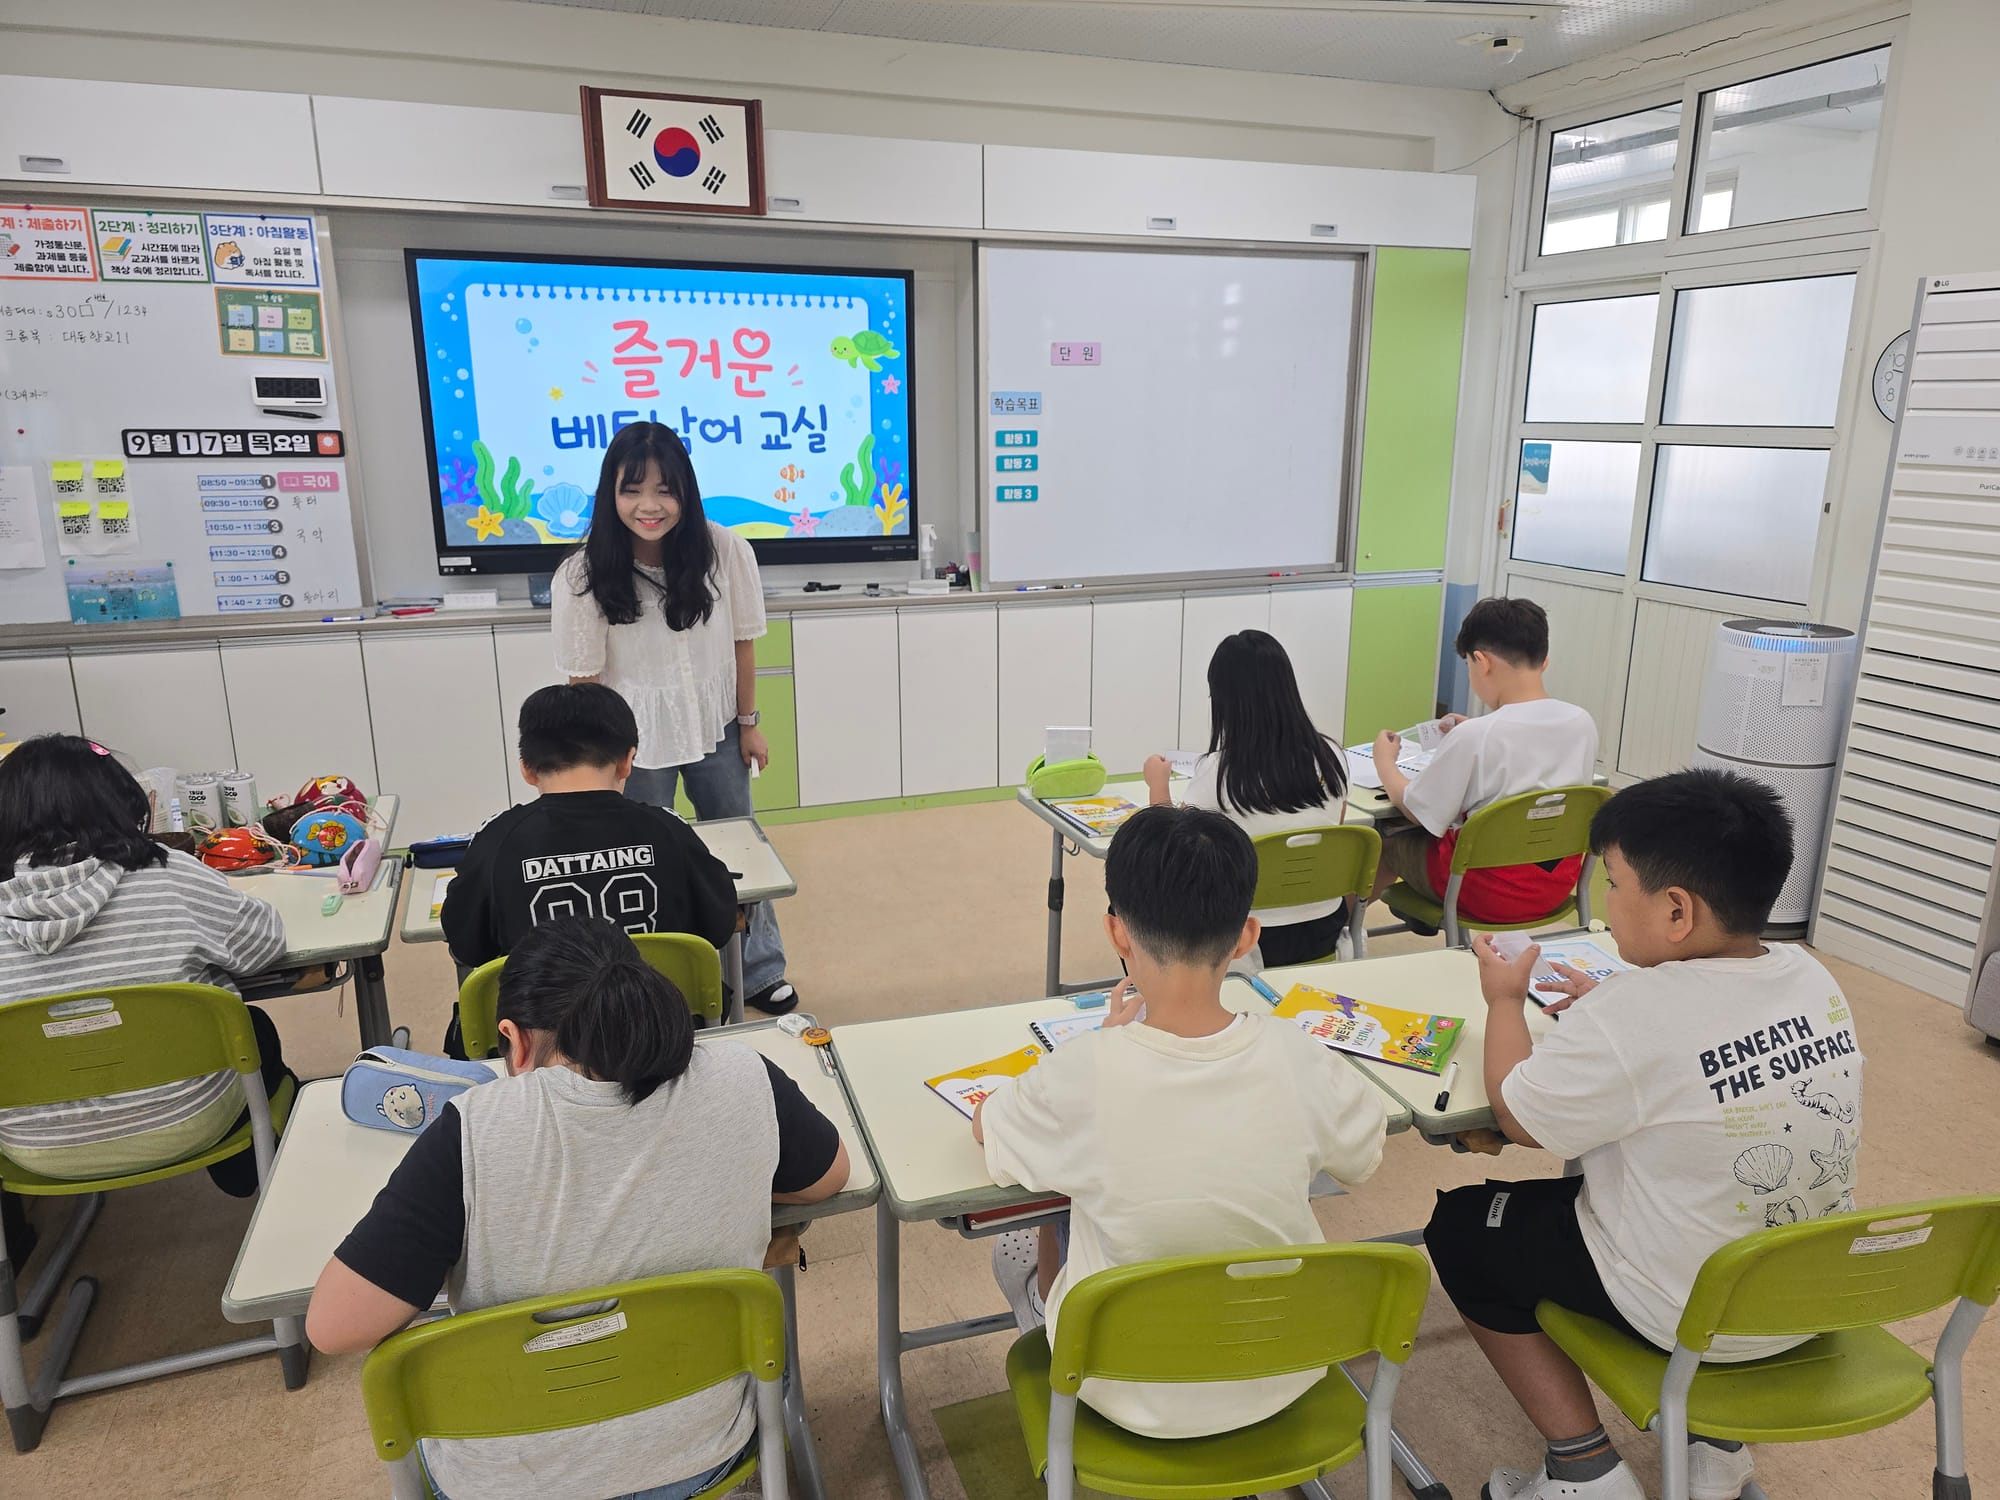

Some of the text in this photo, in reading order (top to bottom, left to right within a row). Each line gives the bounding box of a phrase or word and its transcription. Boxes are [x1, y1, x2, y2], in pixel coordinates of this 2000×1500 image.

[26, 218, 82, 231] 제출하기
[98, 220, 136, 233] 2단계
[146, 222, 198, 235] 정리하기
[209, 225, 246, 237] 3단계
[256, 226, 309, 240] 아침활동
[141, 243, 200, 253] 시간표에 따라
[273, 247, 291, 256] 요일
[36, 252, 66, 261] 과제물
[131, 255, 200, 264] 교과서를 바르게
[253, 258, 271, 266] 아침
[274, 259, 292, 267] 활동
[57, 264, 90, 274] 냅니다.
[111, 266, 204, 277] 책상 속에 정리합니다.
[245, 269, 305, 279] 독서를 합니다.
[612, 320, 774, 399] 즐거운
[1885, 371, 1894, 384] 9
[1886, 388, 1895, 402] 8
[993, 397, 1039, 412] 학습목표
[759, 403, 828, 454] 교실
[131, 434, 312, 453] 9월 17일 목요일
[1024, 457, 1032, 469] 2
[302, 475, 331, 488] 국어
[1024, 488, 1032, 500] 3
[525, 847, 651, 880] DATTAING
[1699, 1015, 1815, 1078] BENEATH
[1709, 1030, 1856, 1104] THE SURFACE
